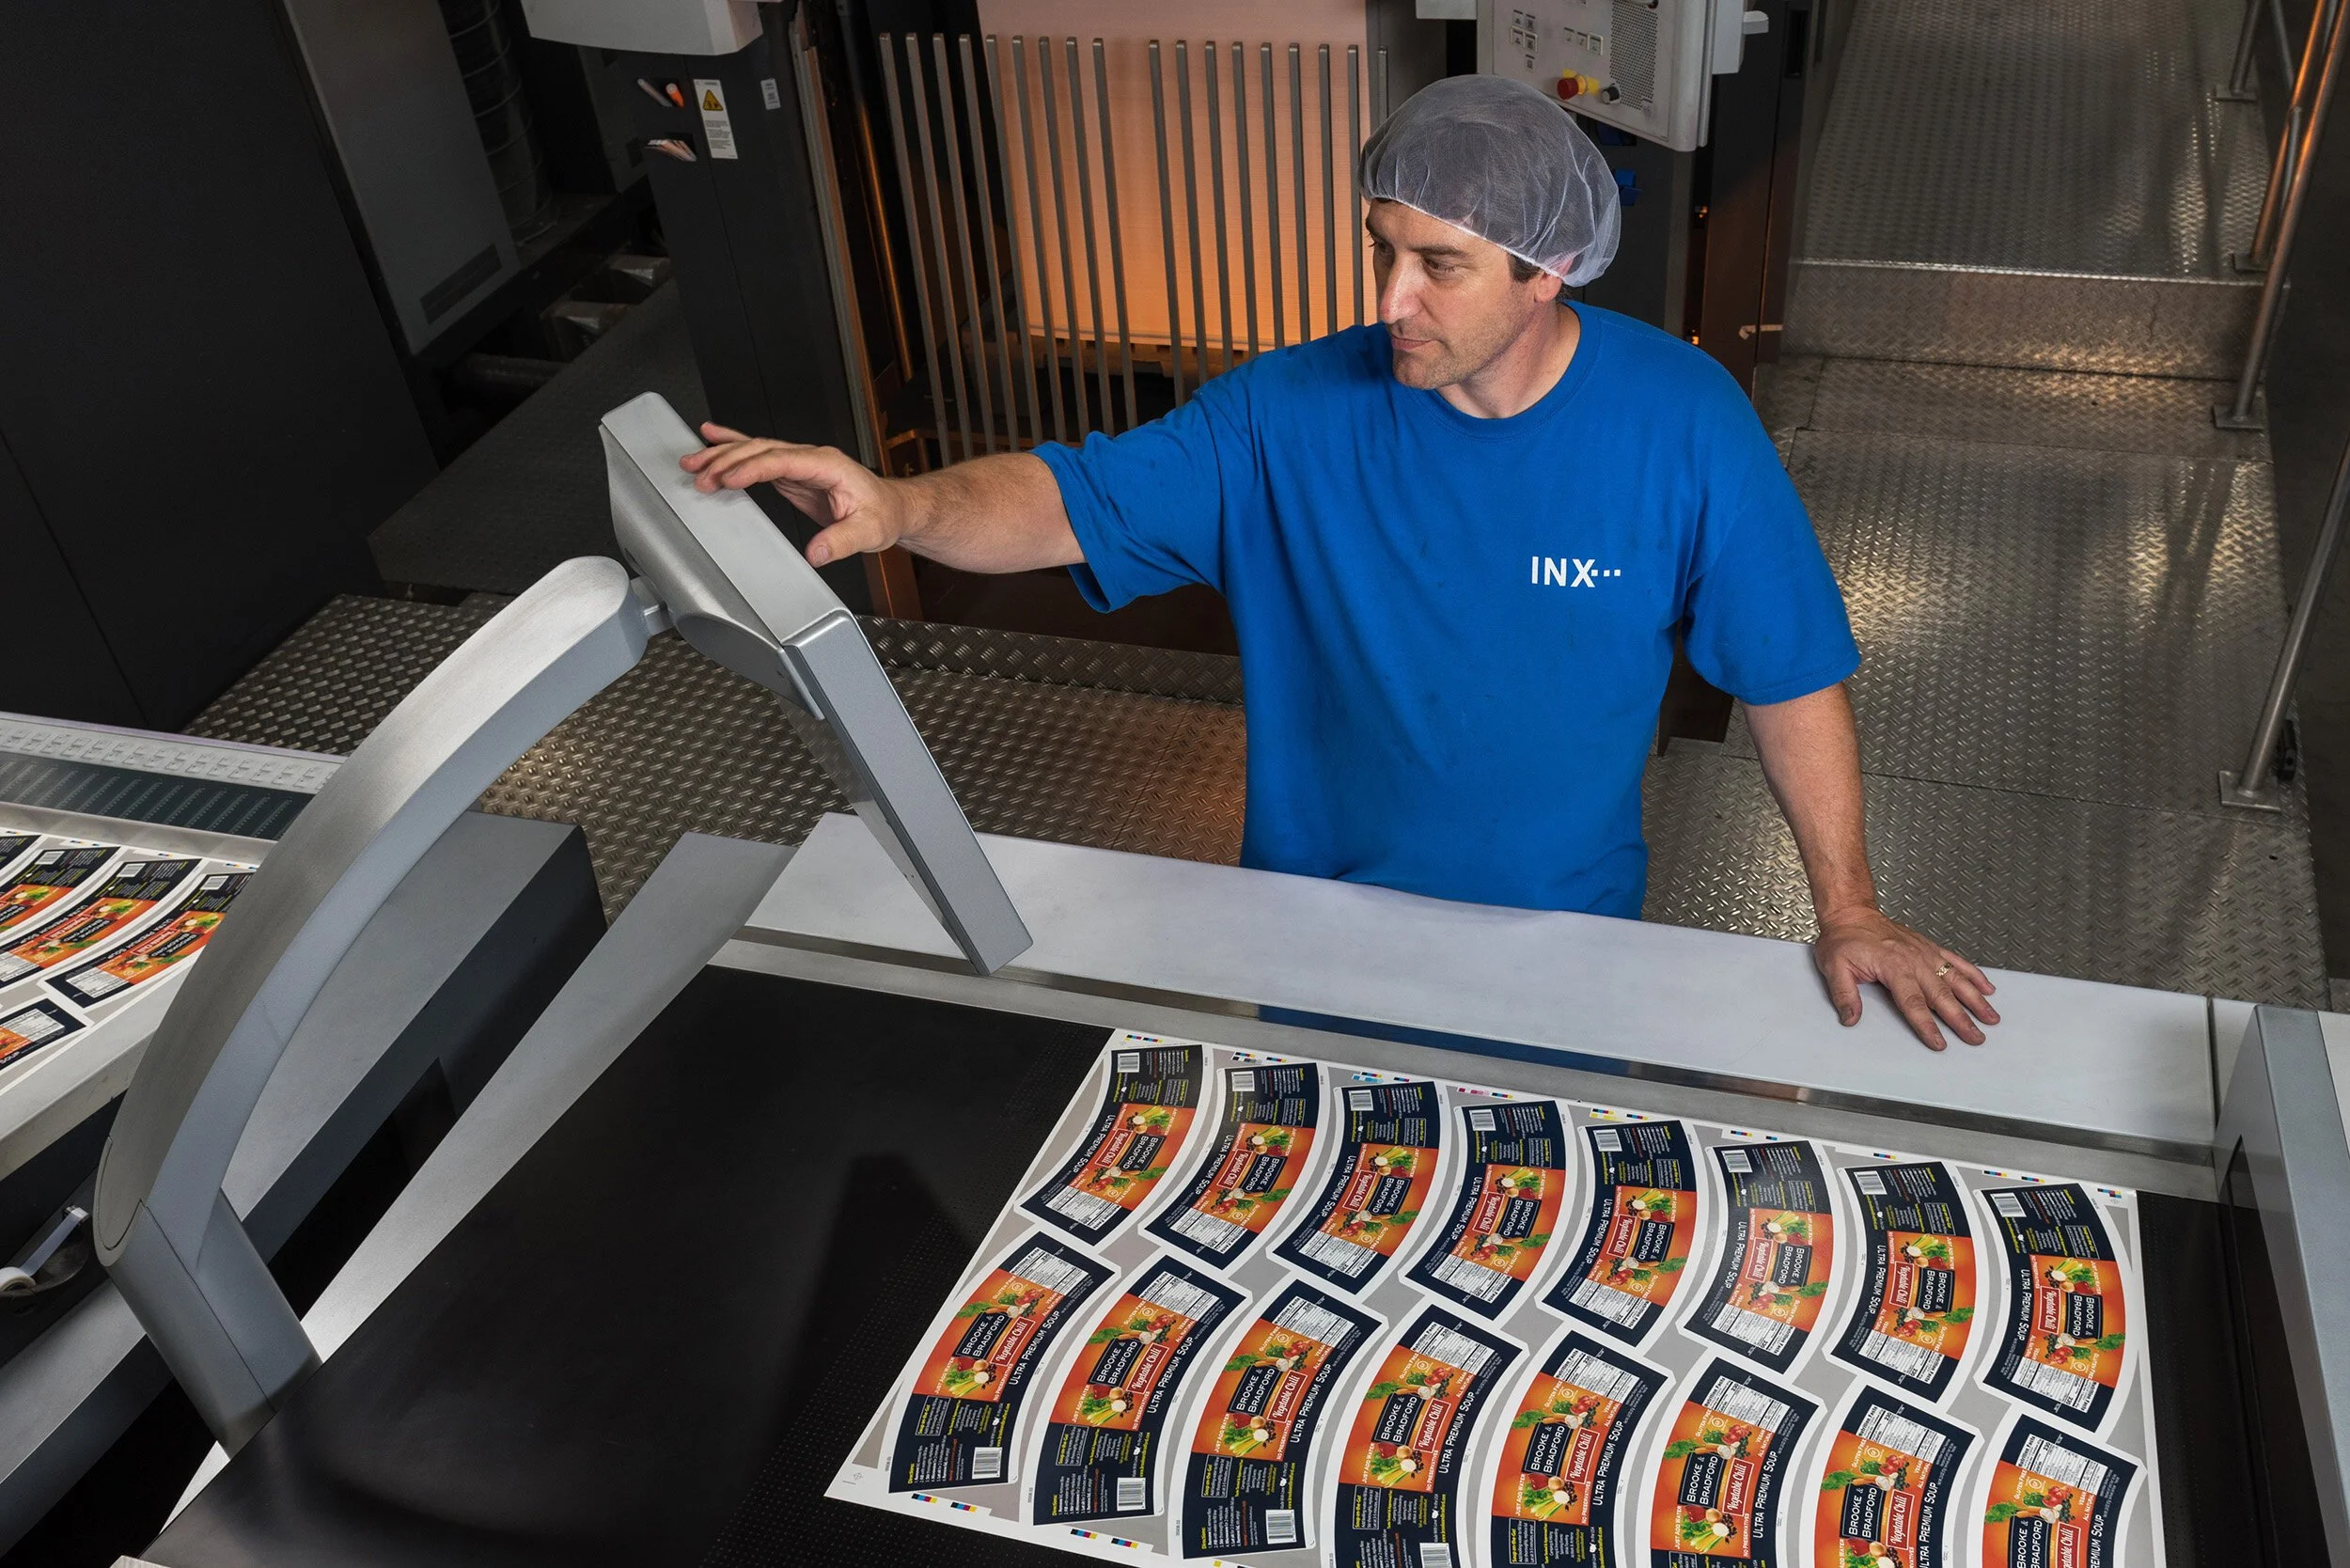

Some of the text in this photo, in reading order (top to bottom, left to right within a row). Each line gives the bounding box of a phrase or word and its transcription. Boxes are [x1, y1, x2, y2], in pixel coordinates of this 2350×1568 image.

[1072, 1114, 1116, 1173] ULTRA PREMIUM SOUP
[1122, 1135, 1149, 1169] BRADFORD
[1136, 1137, 1158, 1164] BROOKE
[1194, 1135, 1234, 1195] ULTRA PREMIUM SOUP
[1245, 1155, 1270, 1191] BRADFORD
[1259, 1157, 1279, 1185] BROOKE
[1320, 1155, 1356, 1217] ULTRA PREMIUM SOUP
[1371, 1177, 1394, 1214] BRADFORD
[1386, 1179, 1404, 1208] BROOKE
[1449, 1177, 1482, 1240] ULTRA PREMIUM SOUP
[1502, 1199, 1523, 1236] BRADFORD
[1516, 1200, 1533, 1231] BROOKE
[1584, 1199, 1612, 1264] ULTRA PREMIUM SOUP
[1637, 1221, 1655, 1260] BRADFORD
[1651, 1223, 1667, 1254] BROOKE
[1723, 1221, 1747, 1289] ULTRA PREMIUM SOUP
[1778, 1245, 1793, 1284] BRADFORD
[1791, 1247, 1805, 1278] BROOKE
[1867, 1245, 1886, 1314] ULTRA PREMIUM SOUP
[1922, 1269, 1935, 1310] BRADFORD
[1935, 1271, 1947, 1304] BROOKE
[2016, 1269, 2031, 1341] ULTRA PREMIUM SOUP
[2072, 1294, 2082, 1337] BRADFORD
[2085, 1296, 2094, 1330] BROOKE
[961, 1320, 989, 1355] BROOKE
[972, 1313, 1005, 1356] BRADFORD
[1008, 1309, 1059, 1384] ULTRA PREMIUM SOUP
[1095, 1346, 1121, 1382] BROOKE
[1106, 1340, 1137, 1384] BRADFORD
[1146, 1336, 1193, 1412] ULTRA PREMIUM SOUP
[1235, 1373, 1259, 1410] BROOKE
[1246, 1367, 1275, 1413] BRADFORD
[1289, 1363, 1332, 1442] ULTRA PREMIUM SOUP
[1380, 1402, 1402, 1440] BROOKE
[1392, 1395, 1418, 1442] BRADFORD
[1437, 1390, 1475, 1473] ULTRA PREMIUM SOUP
[1529, 1432, 1549, 1470] BROOKE
[1543, 1424, 1565, 1473] BRADFORD
[1591, 1419, 1623, 1505] ULTRA PREMIUM SOUP
[1685, 1462, 1702, 1502] BROOKE
[1699, 1454, 1718, 1505] BRADFORD
[1752, 1450, 1778, 1537] ULTRA PREMIUM SOUP
[1923, 1481, 1937, 1504] SOUP
[1848, 1493, 1862, 1535] BROOKE
[1861, 1485, 1877, 1538] BRADFORD
[1919, 1504, 1934, 1543] PREMIUM
[2091, 1513, 2104, 1537] SOUP
